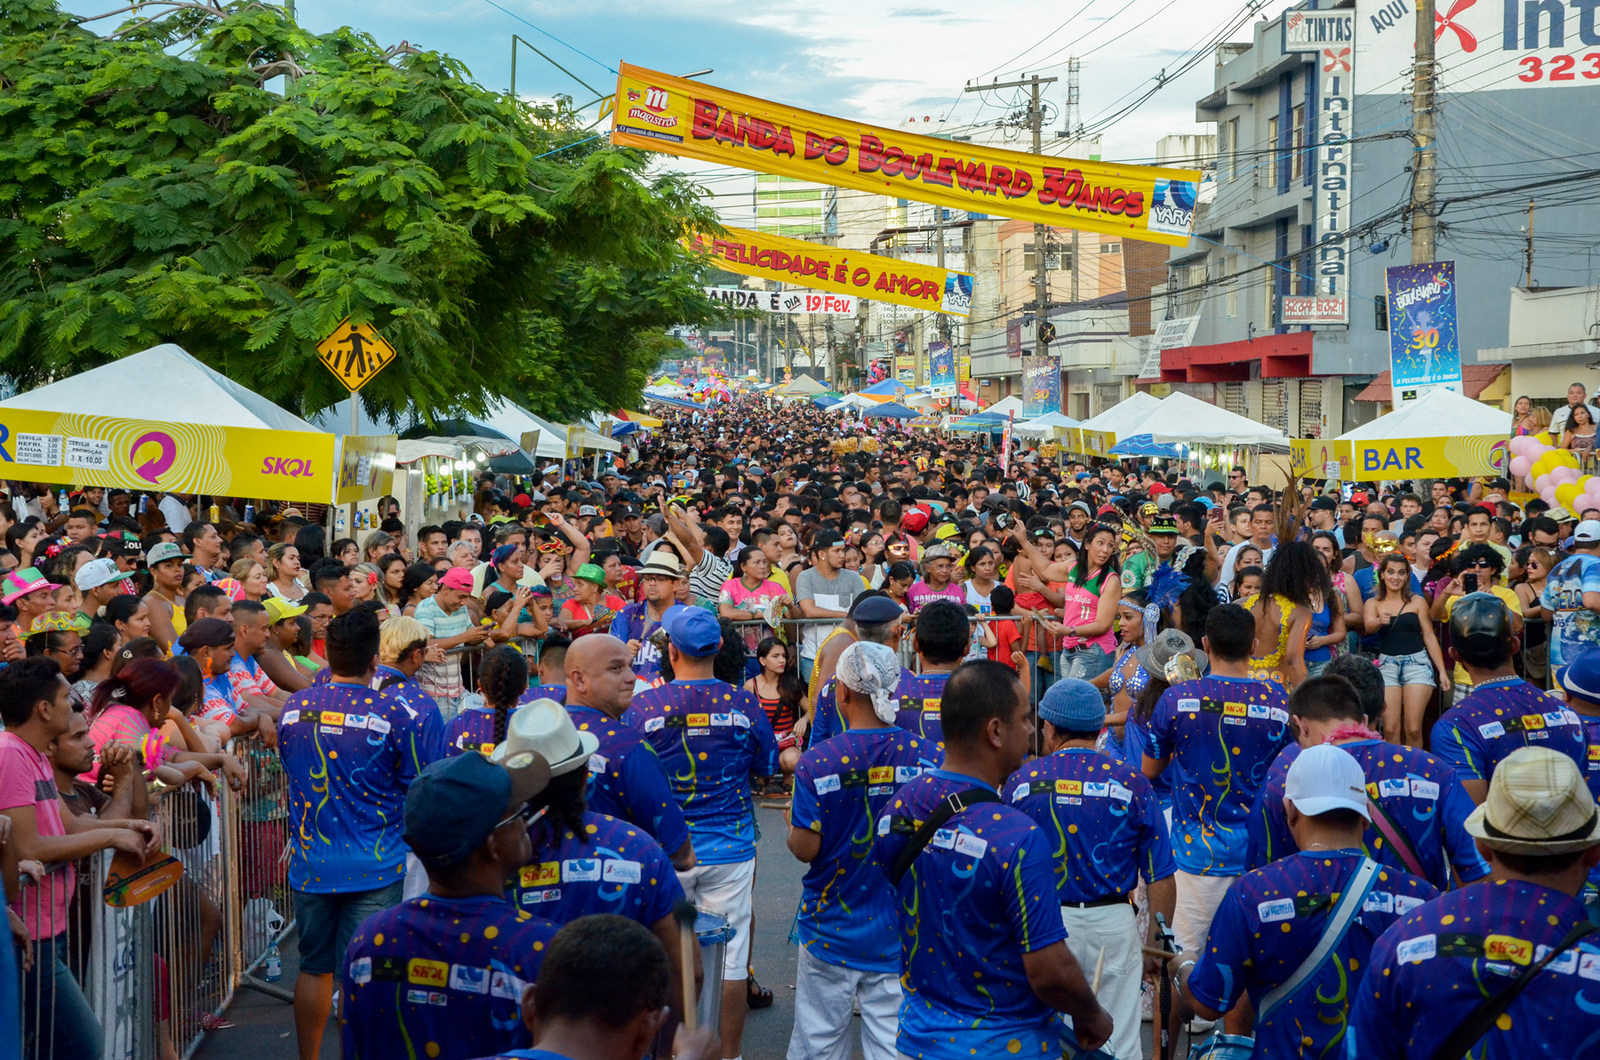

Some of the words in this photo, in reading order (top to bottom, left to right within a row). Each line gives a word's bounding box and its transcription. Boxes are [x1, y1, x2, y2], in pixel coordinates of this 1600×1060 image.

[1288, 11, 1304, 29] AQUI
[1369, 0, 1410, 33] AQUI
[1305, 17, 1352, 42] TINTAS
[629, 109, 678, 127] magistral
[692, 98, 795, 159] BANDA
[804, 131, 849, 166] DO
[857, 134, 1034, 199] BOULEVARD
[1037, 167, 1084, 208] 30
[1075, 183, 1144, 217] ANOS
[1320, 76, 1348, 296] International
[1155, 204, 1193, 226] YARA
[712, 239, 829, 281] FELICIDADE
[834, 258, 848, 284] É
[852, 267, 870, 287] O
[874, 271, 940, 302] AMOR
[784, 295, 802, 310] DIA
[947, 292, 971, 307] YAR
[1396, 282, 1441, 309] BOULEVARD
[1412, 328, 1440, 349] 30
[1033, 389, 1050, 400] 30
[71, 454, 75, 462] 3
[72, 447, 103, 456] PROMOÇÃO
[1292, 447, 1307, 468] BAR
[1364, 447, 1424, 471] BAR
[261, 456, 314, 478] SKOL
[1081, 605, 1091, 620] 11
[689, 716, 707, 724] SKOL
[871, 770, 891, 779] SKOL
[1058, 783, 1079, 792] SKOL
[524, 867, 556, 882] SKOL
[1490, 941, 1527, 960] SKOL
[411, 964, 444, 982] SKOL
